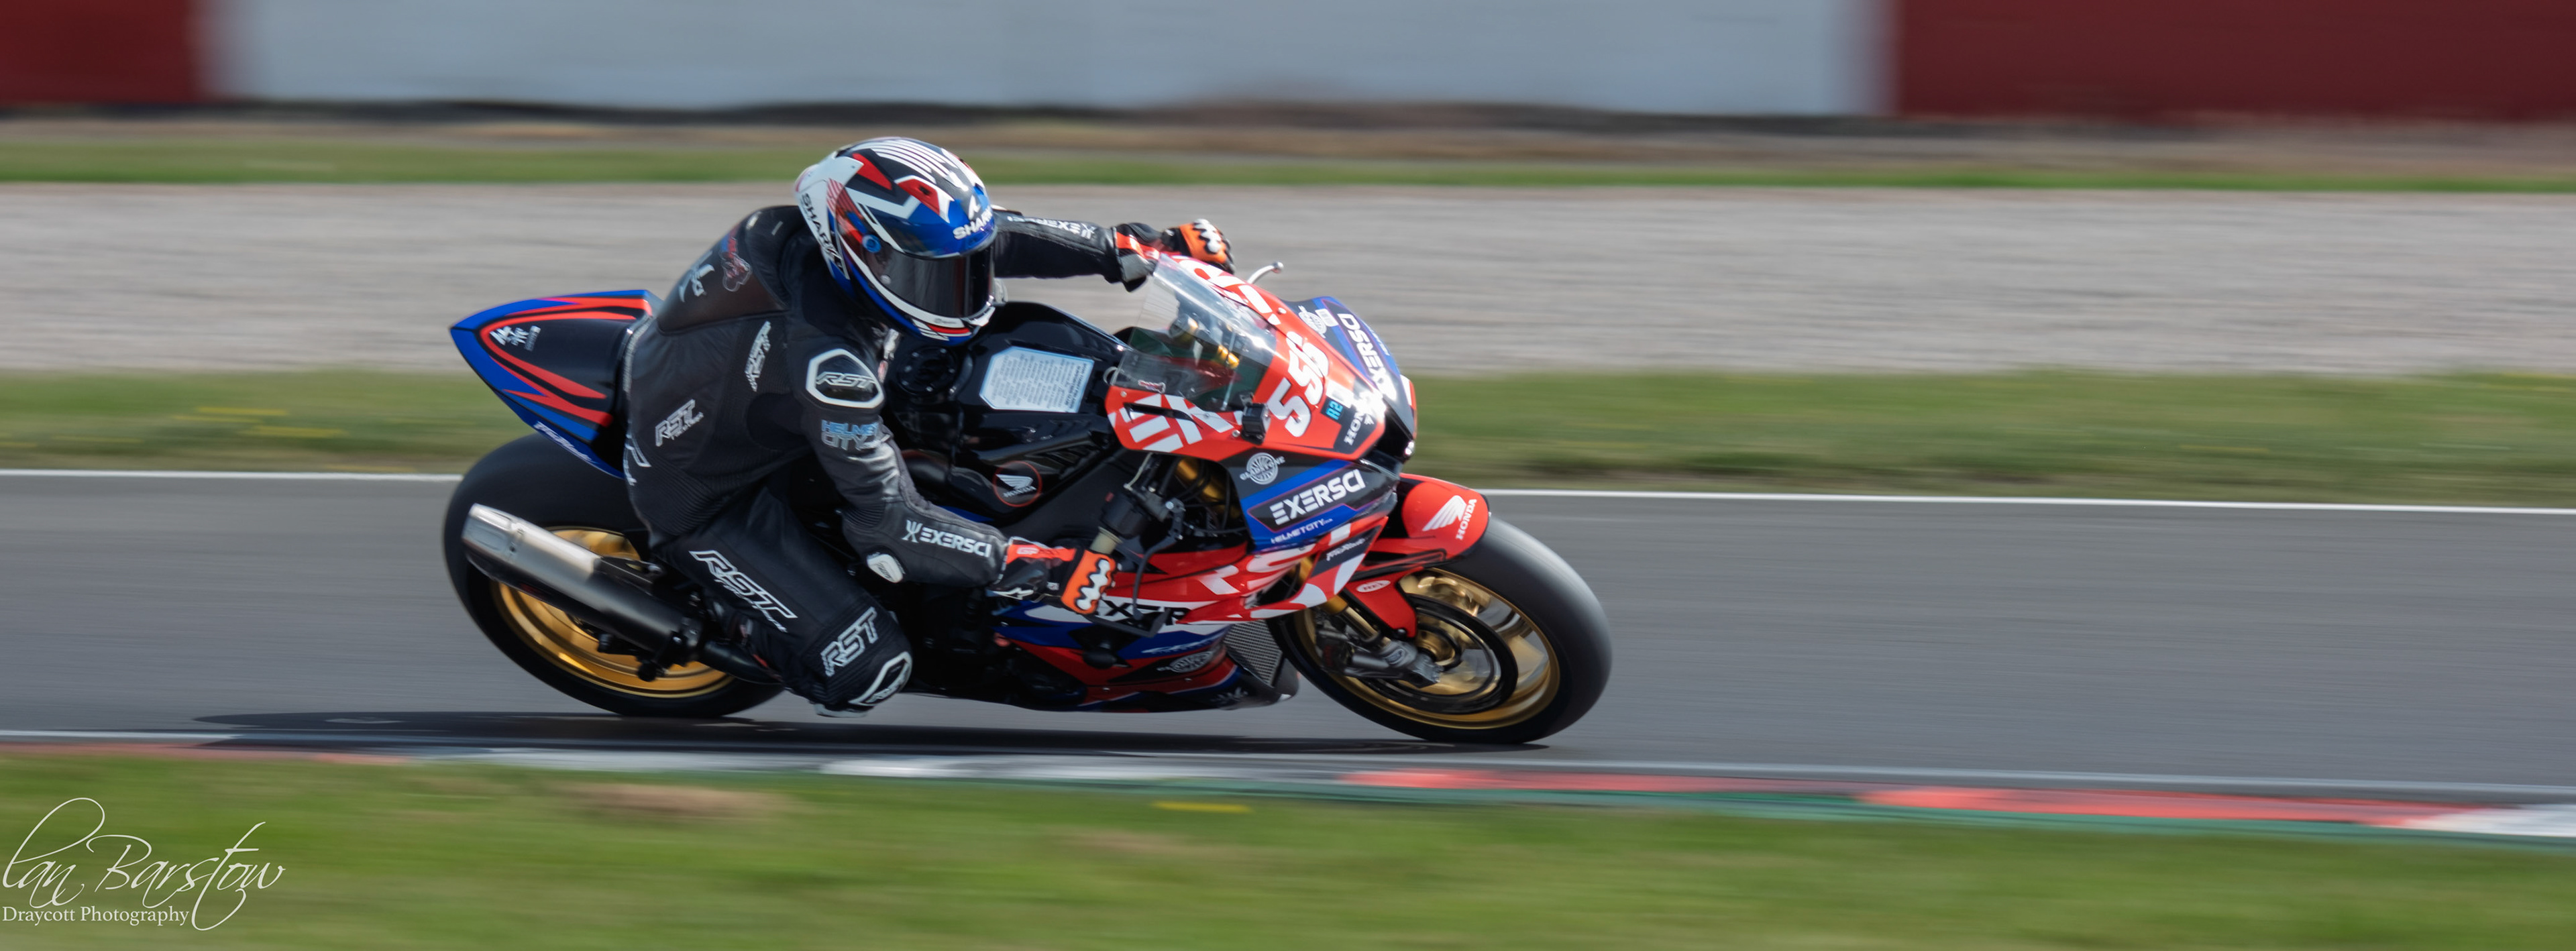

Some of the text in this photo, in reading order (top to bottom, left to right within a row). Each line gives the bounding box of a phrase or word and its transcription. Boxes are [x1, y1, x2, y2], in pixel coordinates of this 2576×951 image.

[816, 372, 876, 388] RST
[1269, 469, 1366, 525] EXERSCI
[1455, 499, 1477, 540] HONDA
[921, 527, 991, 557] EXERSCI
[689, 550, 798, 618] RST
[820, 606, 878, 677] RST
